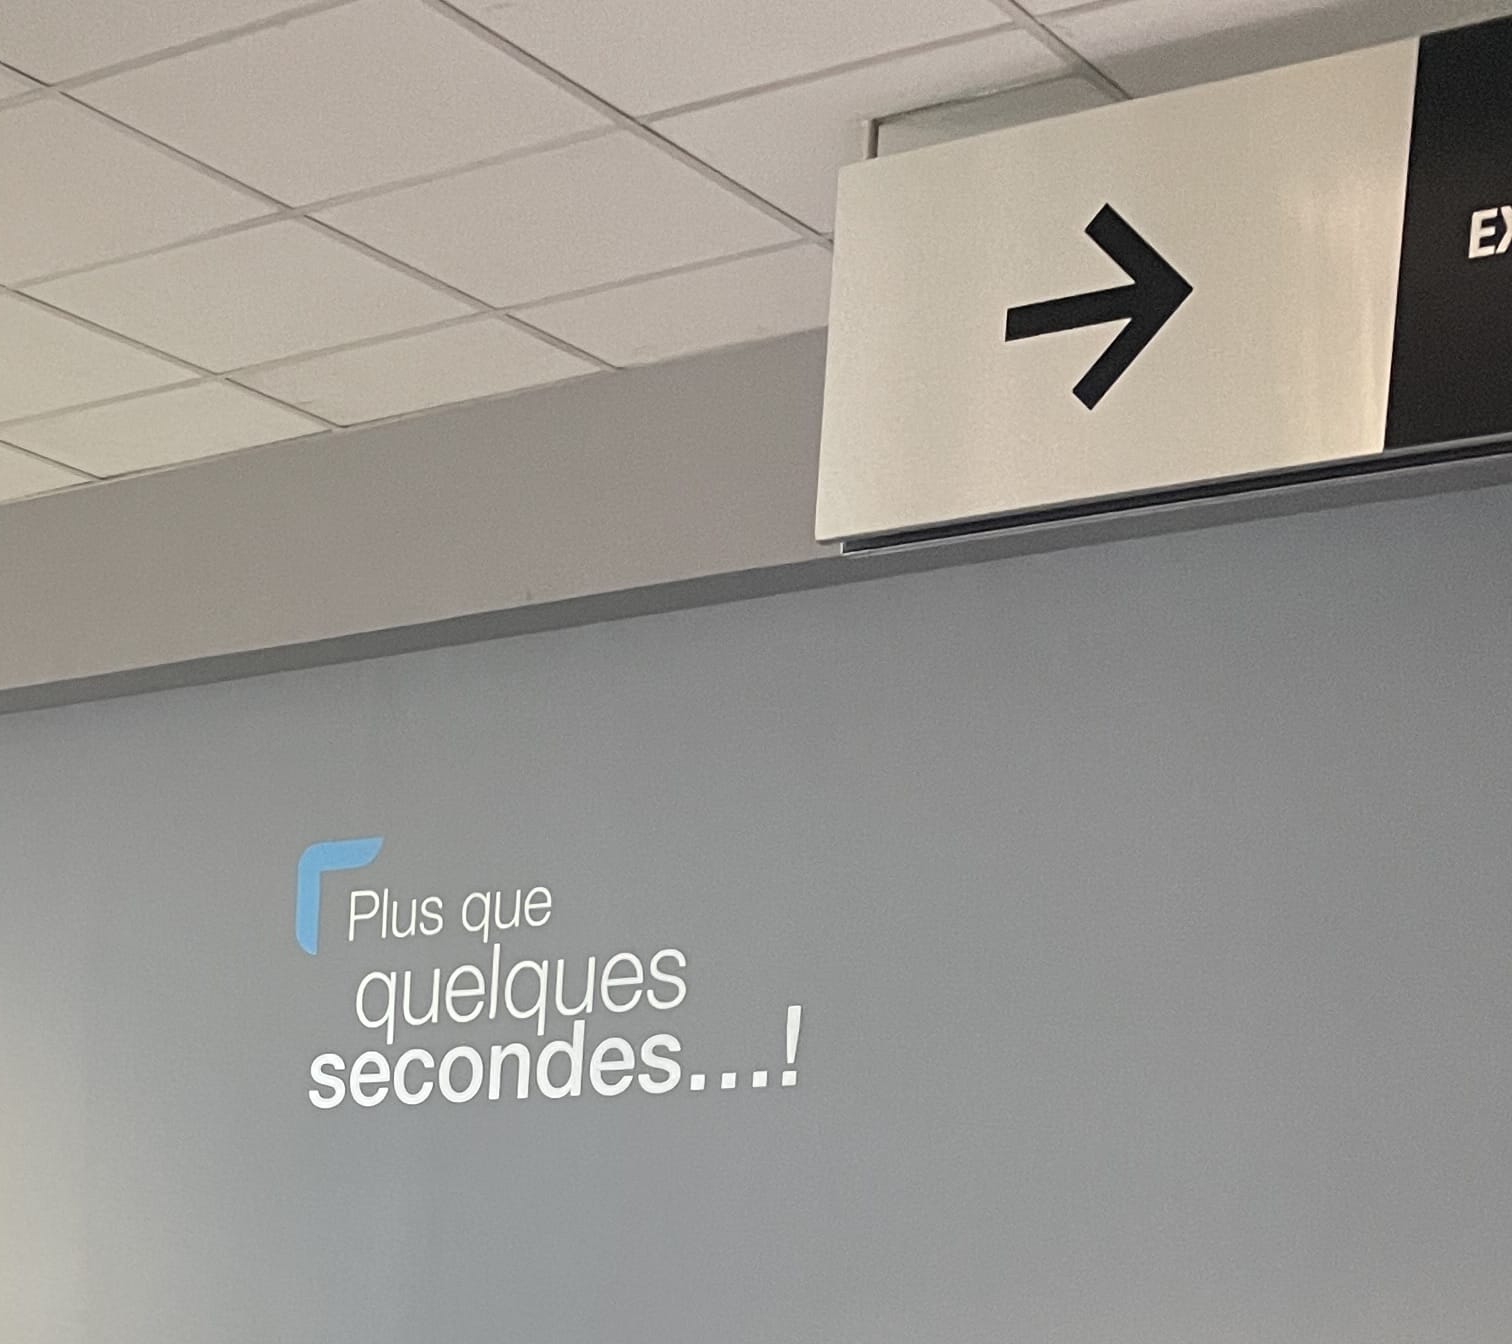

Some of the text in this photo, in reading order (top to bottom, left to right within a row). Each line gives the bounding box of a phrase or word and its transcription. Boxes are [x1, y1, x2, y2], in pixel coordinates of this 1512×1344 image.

[348, 887, 552, 943] Plus que
[355, 943, 688, 1045] quelques
